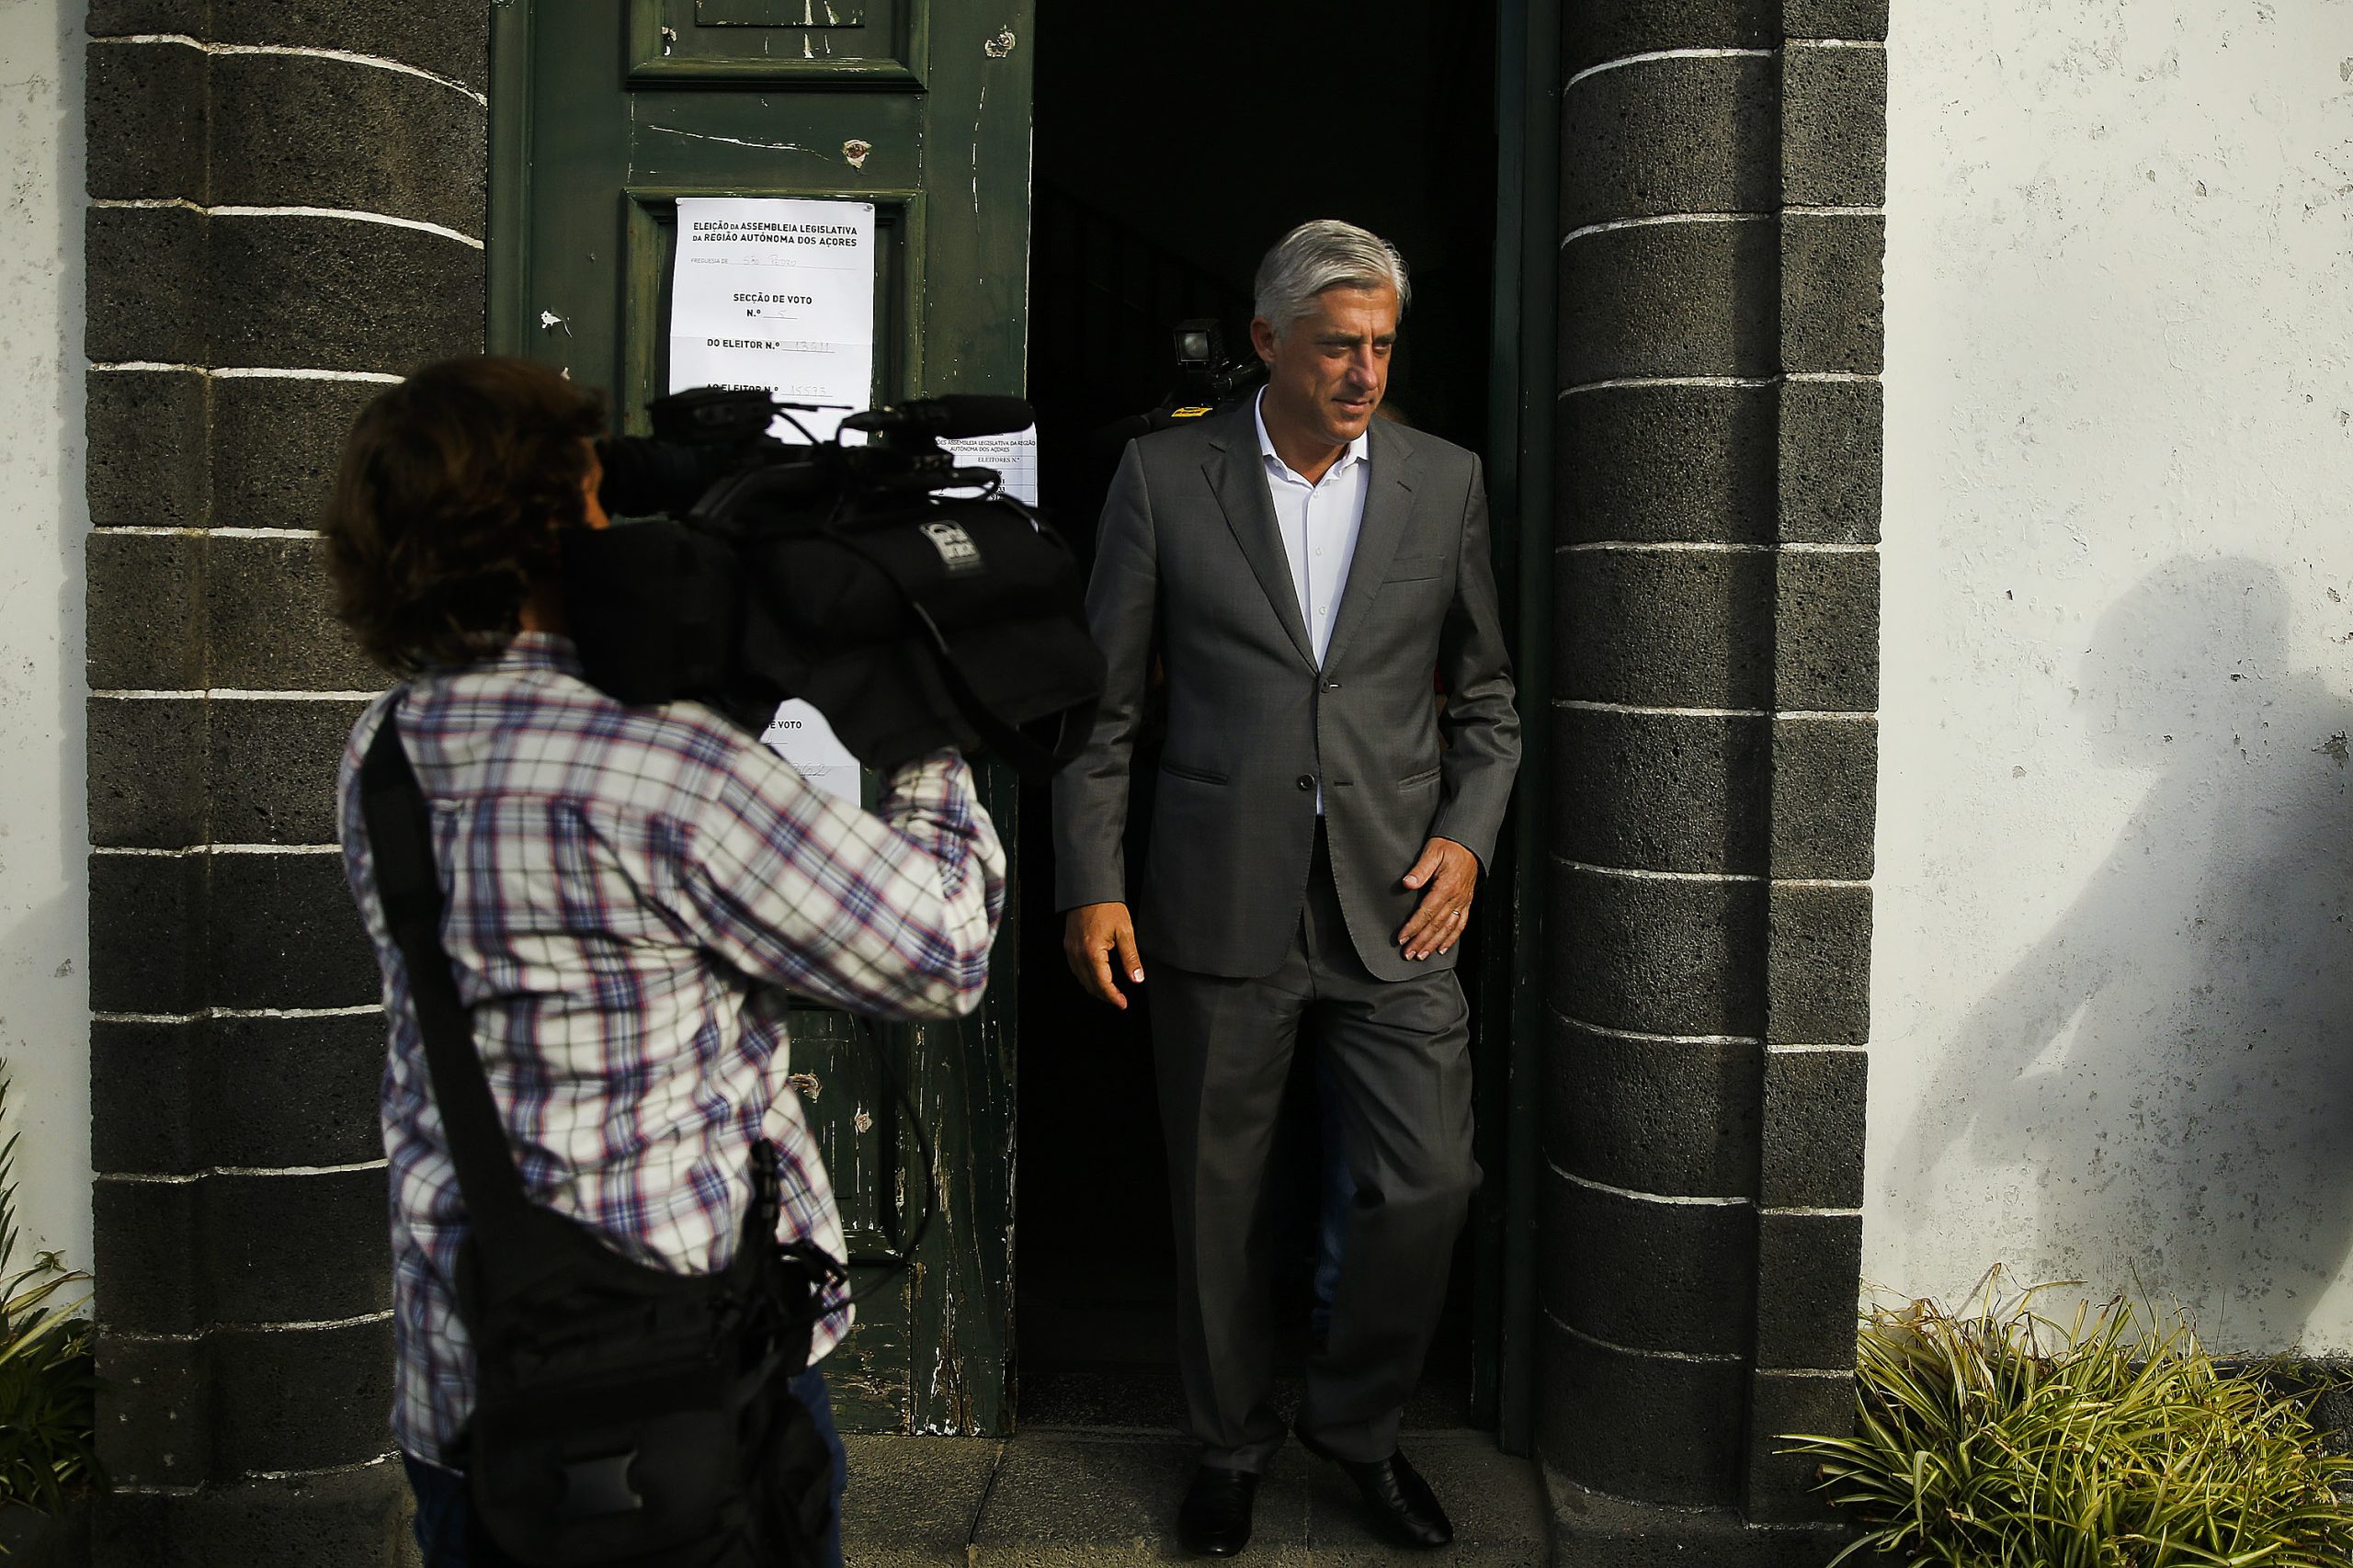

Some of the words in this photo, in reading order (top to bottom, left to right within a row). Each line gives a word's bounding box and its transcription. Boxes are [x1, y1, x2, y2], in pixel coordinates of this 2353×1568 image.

[693, 220, 729, 233] ELEIÇÃO
[740, 222, 798, 233] ASSEMBLEIA
[800, 224, 858, 235] LEGISLATIVA
[704, 232, 738, 242] REGIÃO
[740, 232, 795, 244] AUTÓNOMA
[797, 236, 817, 244] DOS
[819, 237, 858, 248] AÇORES
[733, 291, 770, 304] SECÇÃO
[772, 295, 786, 303] DE
[787, 295, 813, 305] VOTO
[746, 309, 761, 317] N.º
[707, 338, 721, 347] DO
[722, 339, 763, 349] ELEITOR
[765, 341, 780, 350] N.º
[778, 721, 802, 729] VOTO
